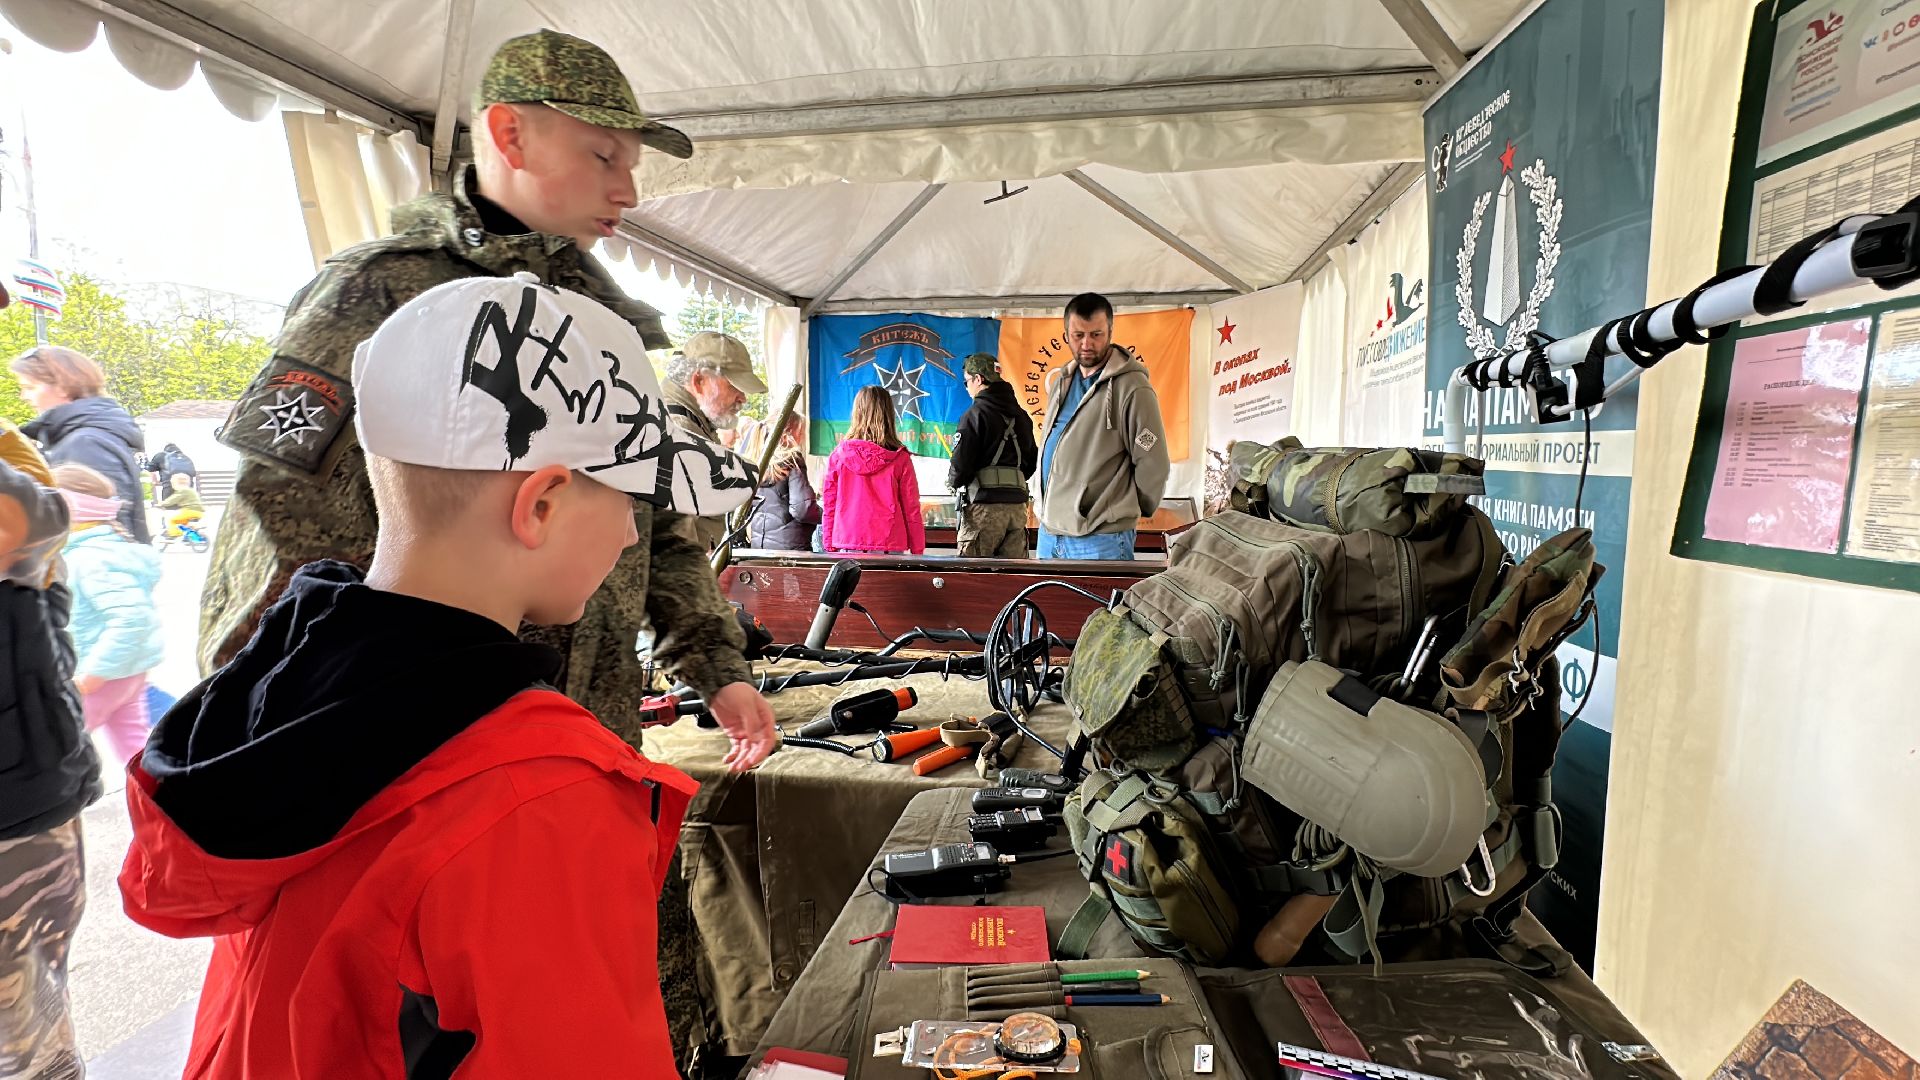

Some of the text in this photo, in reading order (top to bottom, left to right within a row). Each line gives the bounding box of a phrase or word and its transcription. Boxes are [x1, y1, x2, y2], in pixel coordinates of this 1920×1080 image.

[1424, 389, 1479, 430] НАА
[1493, 498, 1528, 526] КНИГА
[1520, 534, 1541, 559] РАЙ
[1549, 870, 1577, 901] СКИХ
